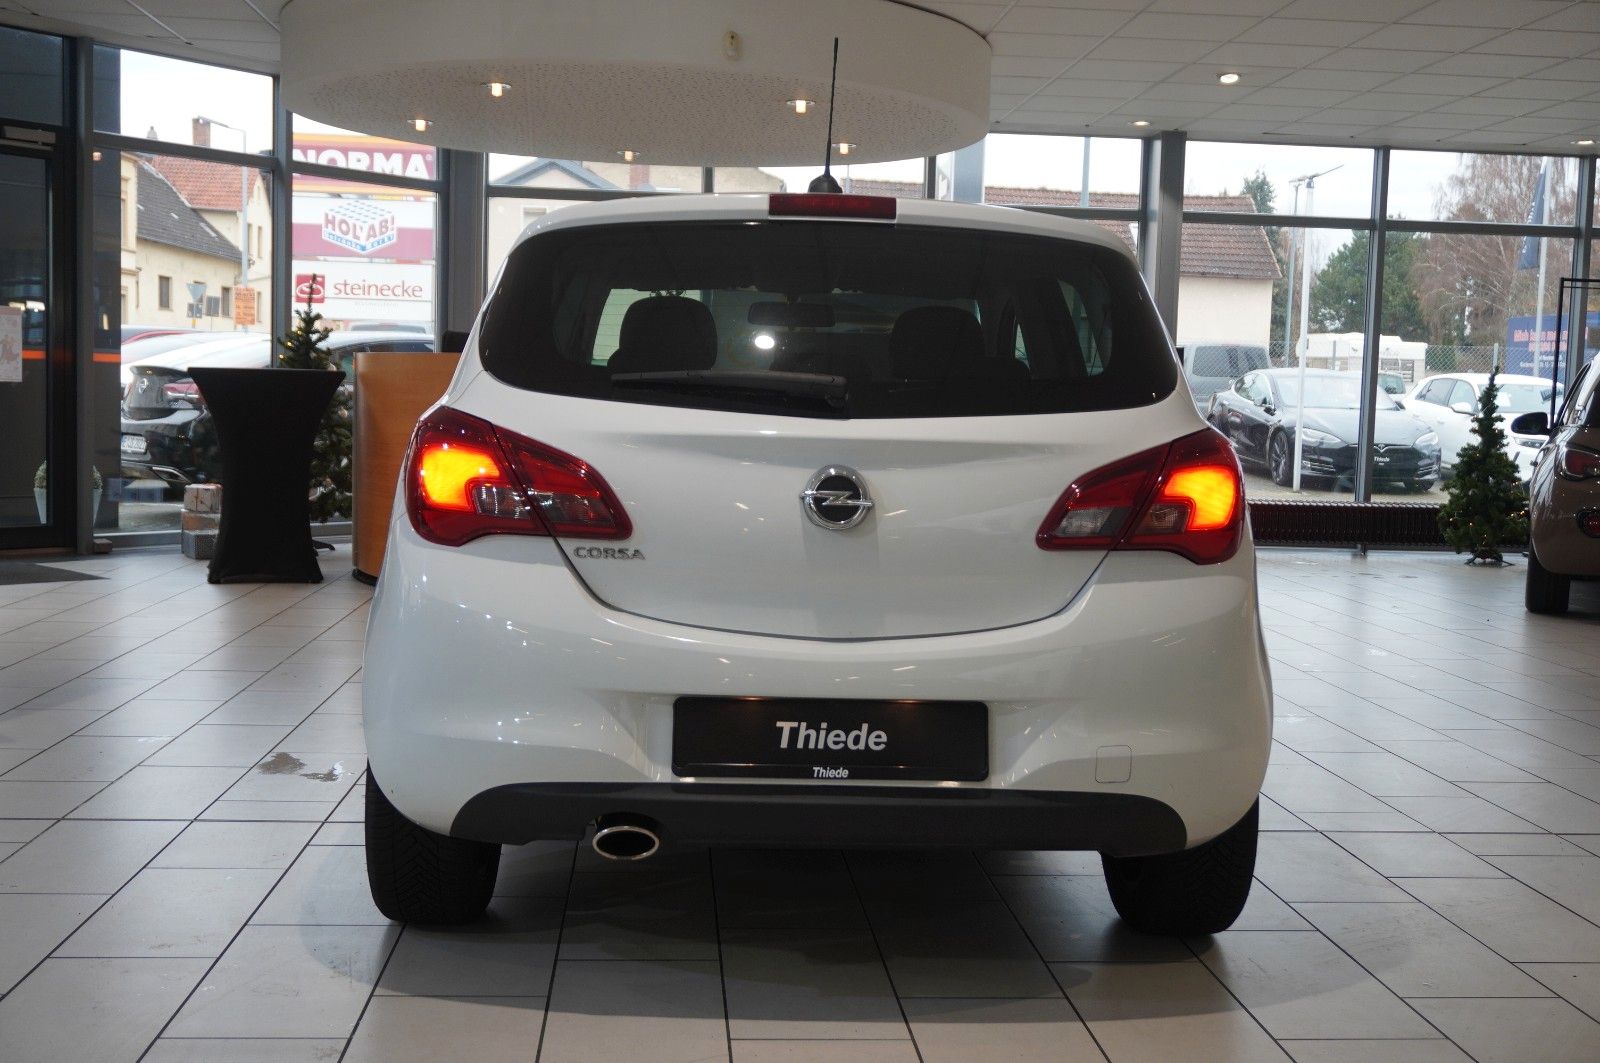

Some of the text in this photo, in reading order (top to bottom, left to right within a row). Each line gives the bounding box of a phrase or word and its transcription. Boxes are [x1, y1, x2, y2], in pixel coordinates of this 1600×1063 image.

[333, 279, 423, 298] steinecke
[573, 546, 646, 560] CORSA
[775, 721, 888, 751] Thiede
[812, 766, 849, 779] Thiede
